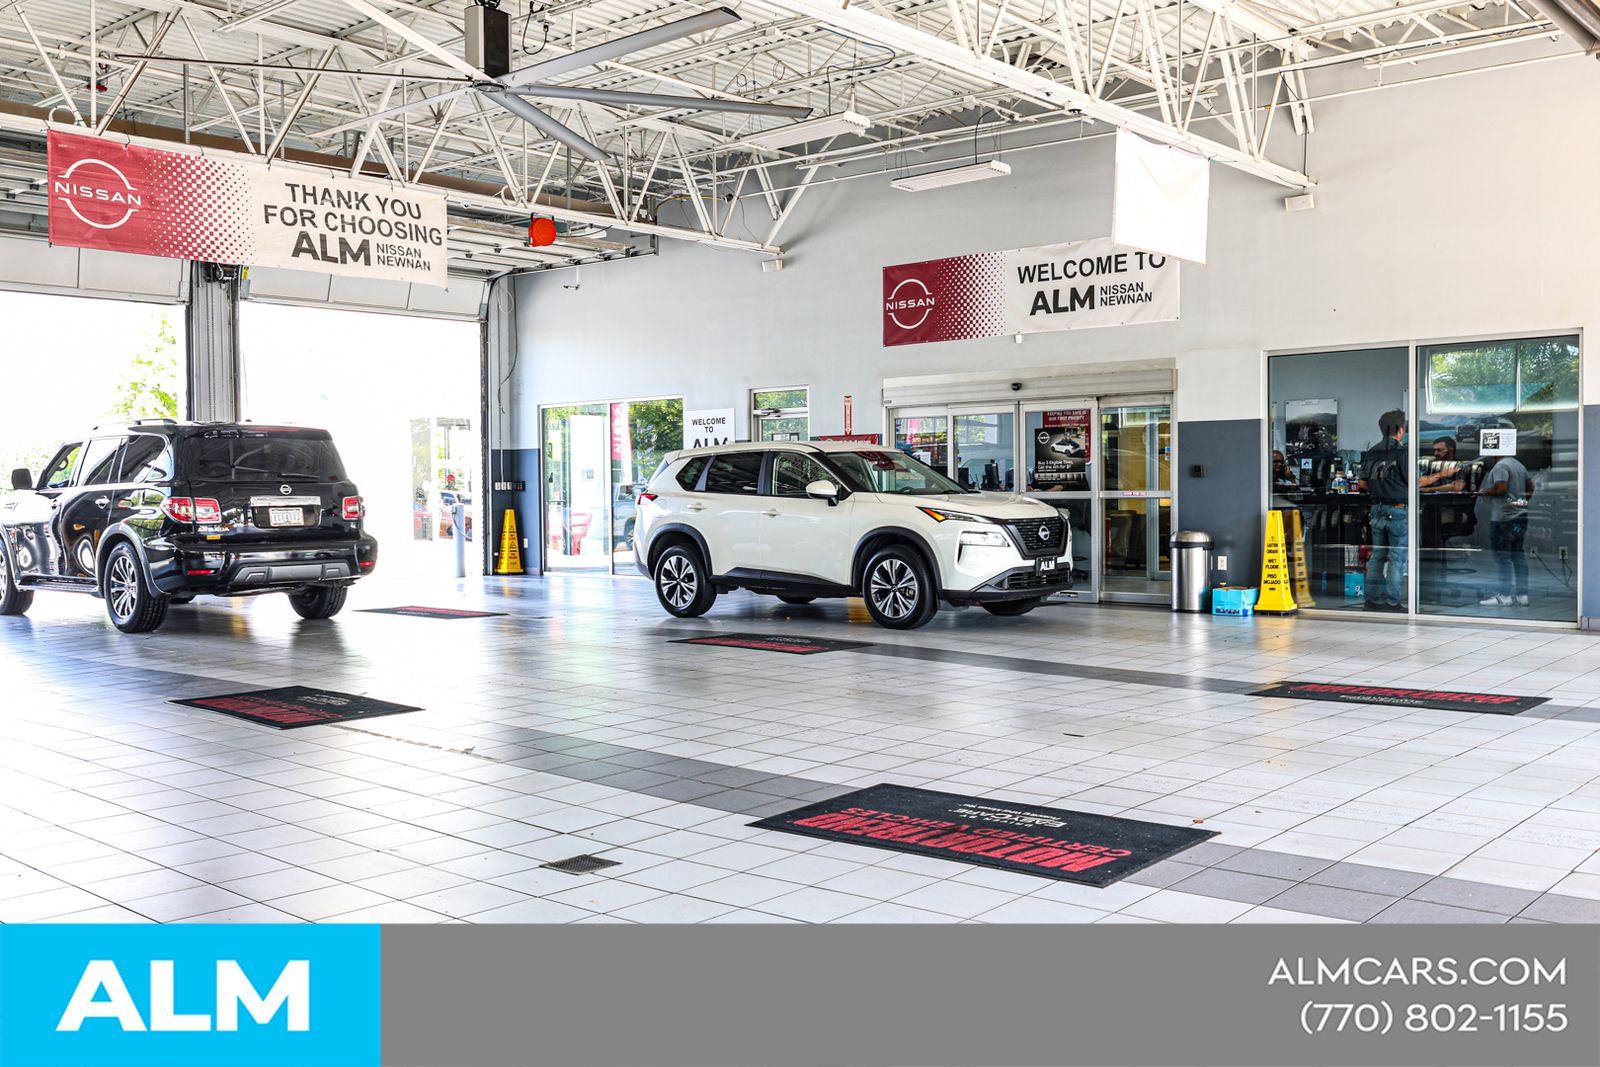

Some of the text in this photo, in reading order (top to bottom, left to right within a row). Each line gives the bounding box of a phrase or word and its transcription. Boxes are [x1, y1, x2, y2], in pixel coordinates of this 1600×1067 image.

[54, 181, 142, 206] NISSAN
[285, 183, 422, 220] THANK YOU
[264, 205, 443, 246] FOR CHOOSING
[291, 231, 371, 266] ALM
[376, 243, 422, 258] NISSAN
[376, 255, 431, 272] NEWNAN
[1017, 251, 1127, 284] WELCOME
[1029, 285, 1096, 316] ALM
[1100, 282, 1144, 296] NISSAN
[1100, 292, 1153, 306] NEWNAN
[886, 296, 935, 311] NISSAN
[692, 417, 726, 426] WELCOME
[1040, 560, 1056, 571] ALM
[789, 811, 1107, 873] MOTORTREND
[841, 807, 1132, 857] CERTIFIED VEHICLES
